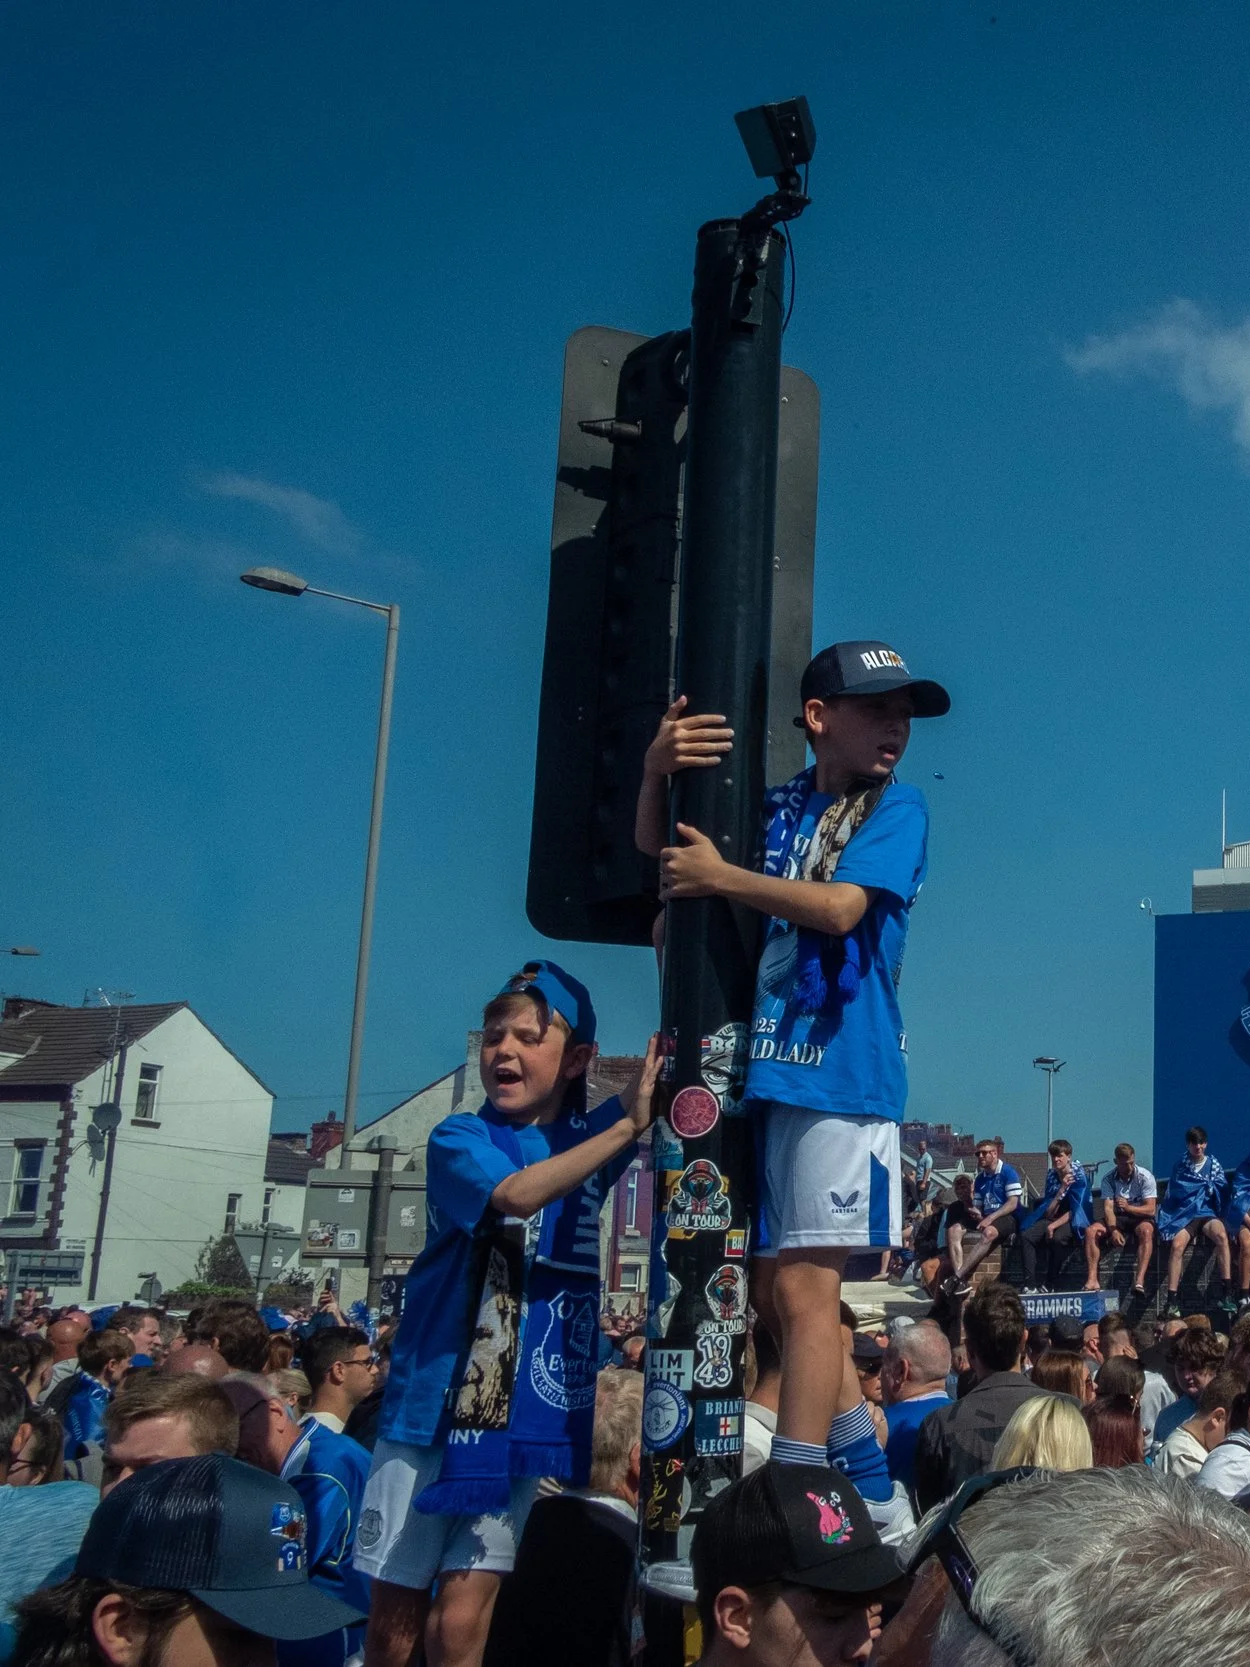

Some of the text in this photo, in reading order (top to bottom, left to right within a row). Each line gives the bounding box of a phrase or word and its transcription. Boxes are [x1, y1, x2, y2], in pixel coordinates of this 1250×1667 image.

[775, 1040, 829, 1067] LADY
[831, 1206, 858, 1214] CASTORE
[674, 1213, 722, 1228] ON TOUR
[702, 1335, 728, 1360] 19
[549, 1353, 599, 1372] Everto
[650, 1353, 683, 1369] LIM
[286, 1550, 295, 1567] 9
